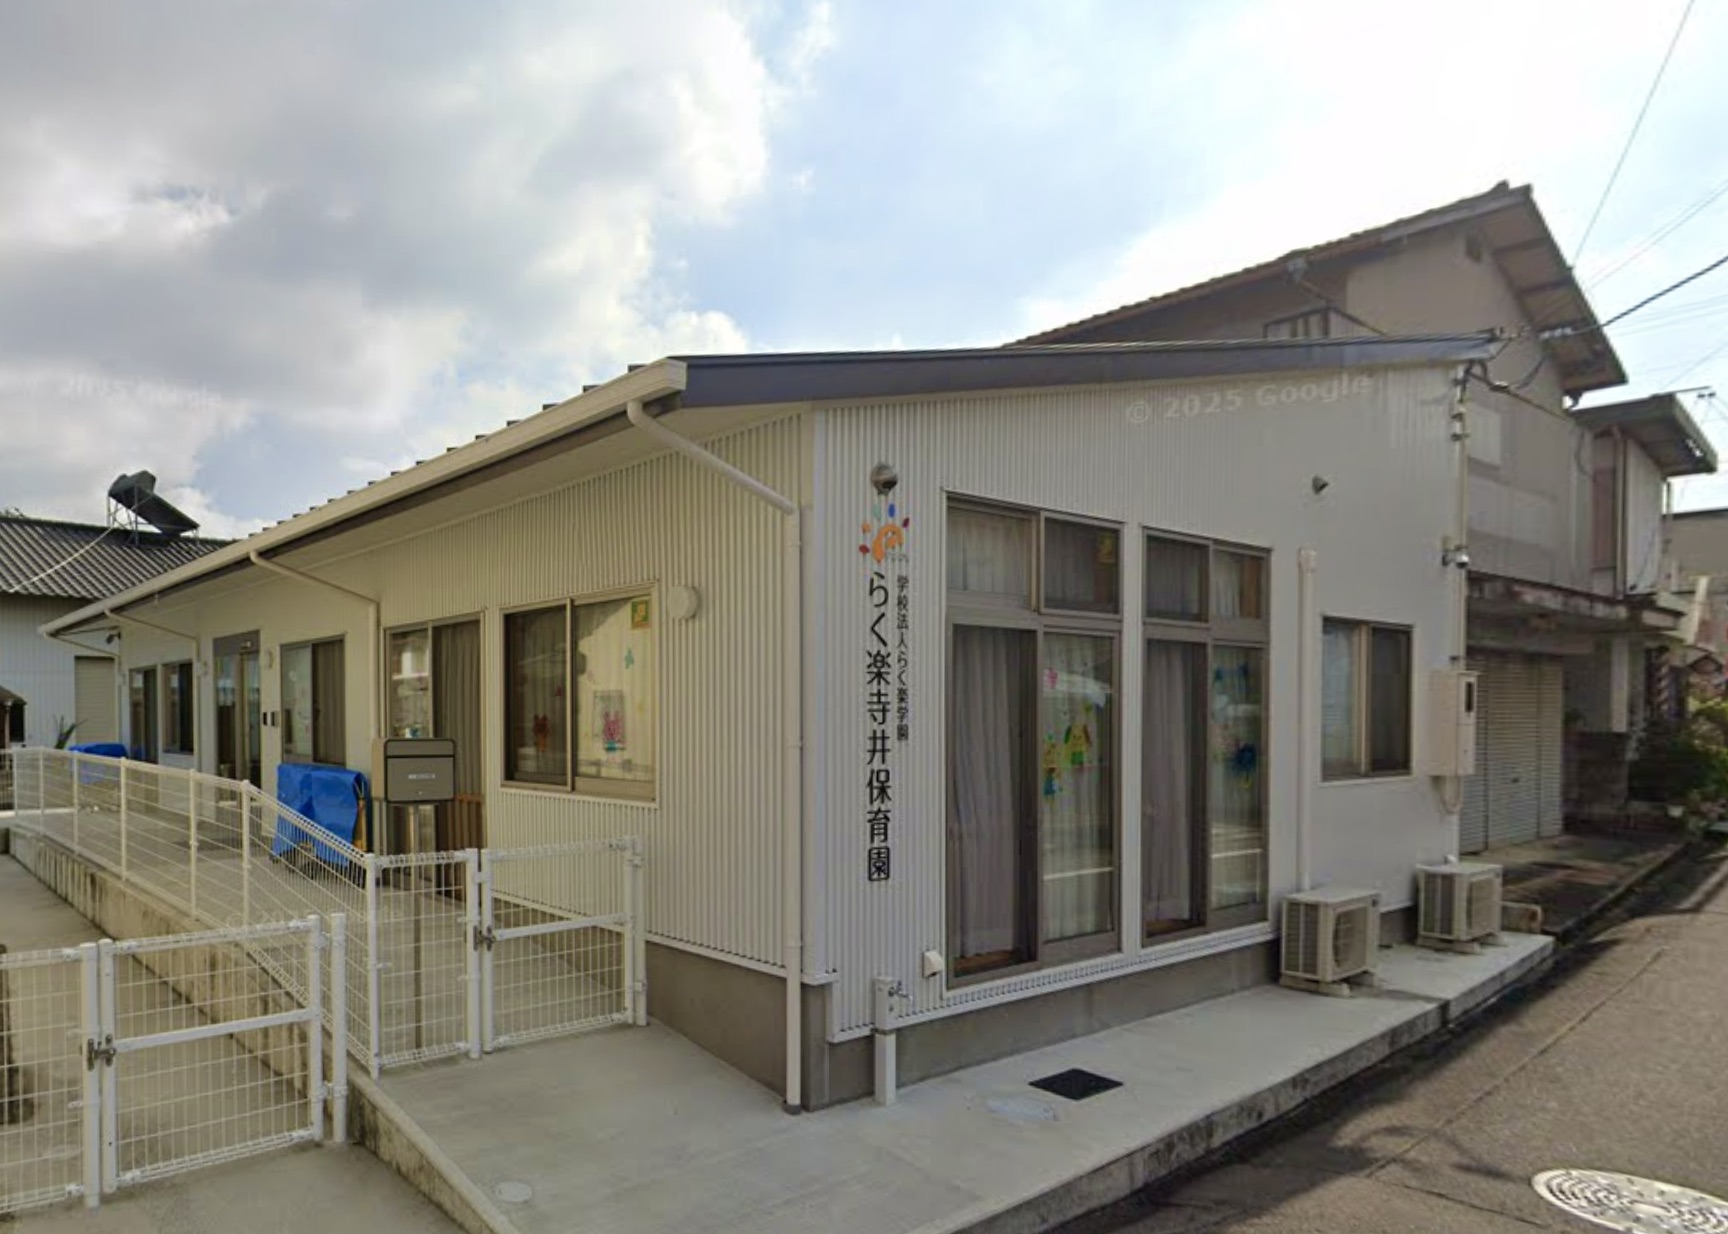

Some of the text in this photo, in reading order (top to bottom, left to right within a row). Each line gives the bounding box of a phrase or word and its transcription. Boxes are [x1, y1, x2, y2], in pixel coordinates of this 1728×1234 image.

[866, 572, 892, 881] らく楽寺井保育園
